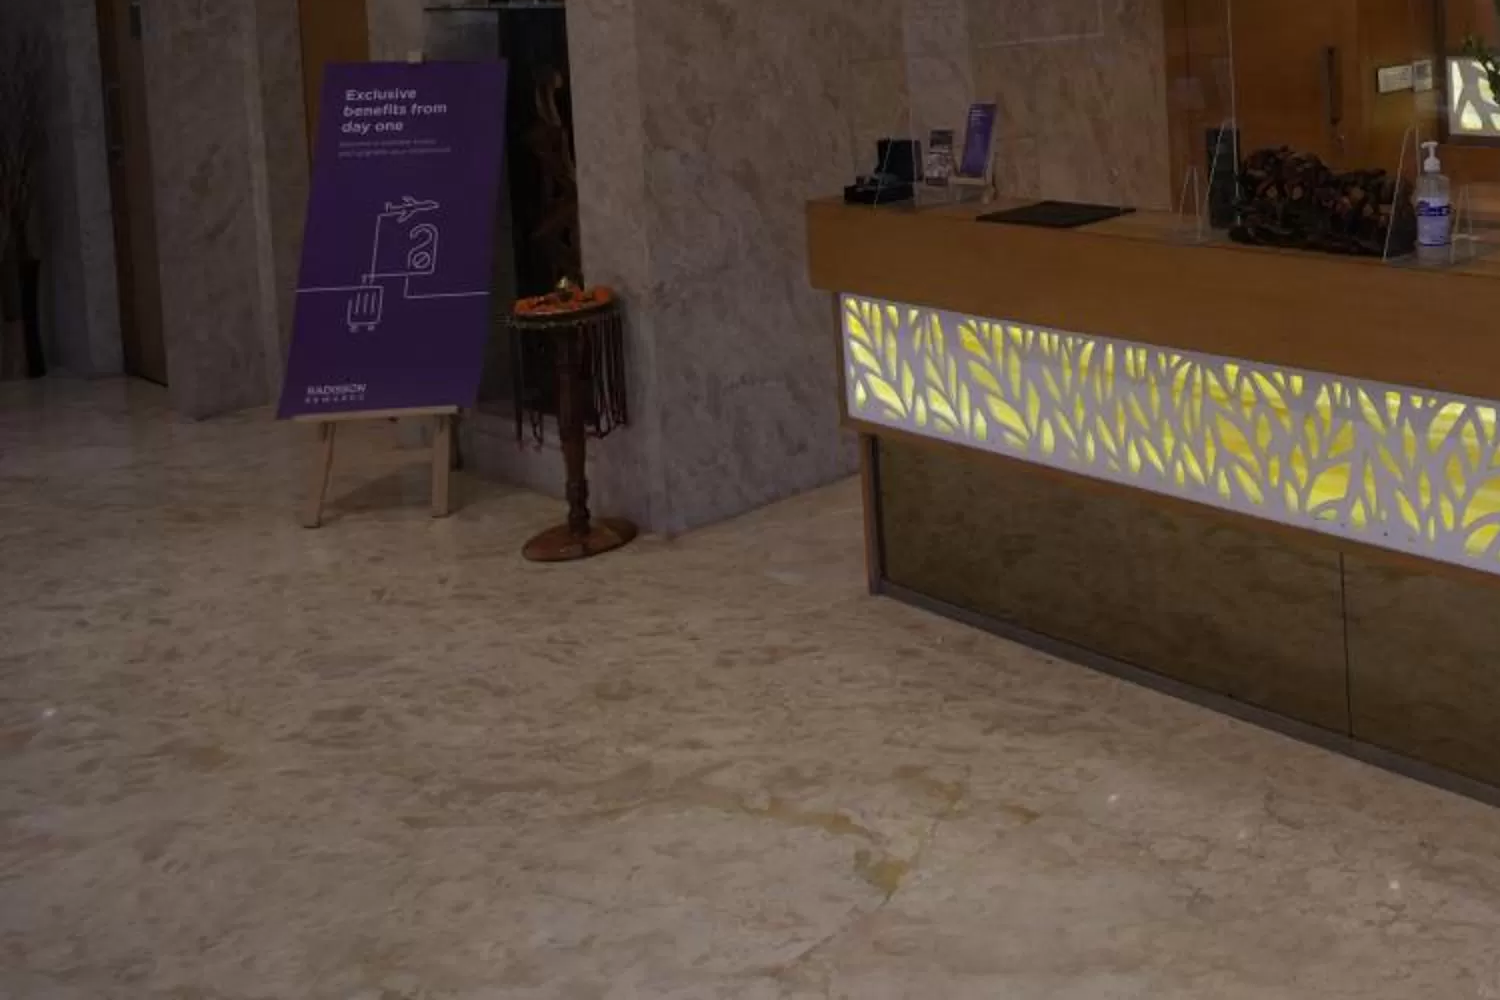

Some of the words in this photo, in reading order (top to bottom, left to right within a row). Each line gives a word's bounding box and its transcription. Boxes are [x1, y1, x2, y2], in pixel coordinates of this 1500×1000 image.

[345, 88, 417, 101] Exclusive
[342, 103, 407, 117] benefits
[410, 103, 448, 116] from
[341, 120, 371, 135] day
[374, 121, 404, 133] one
